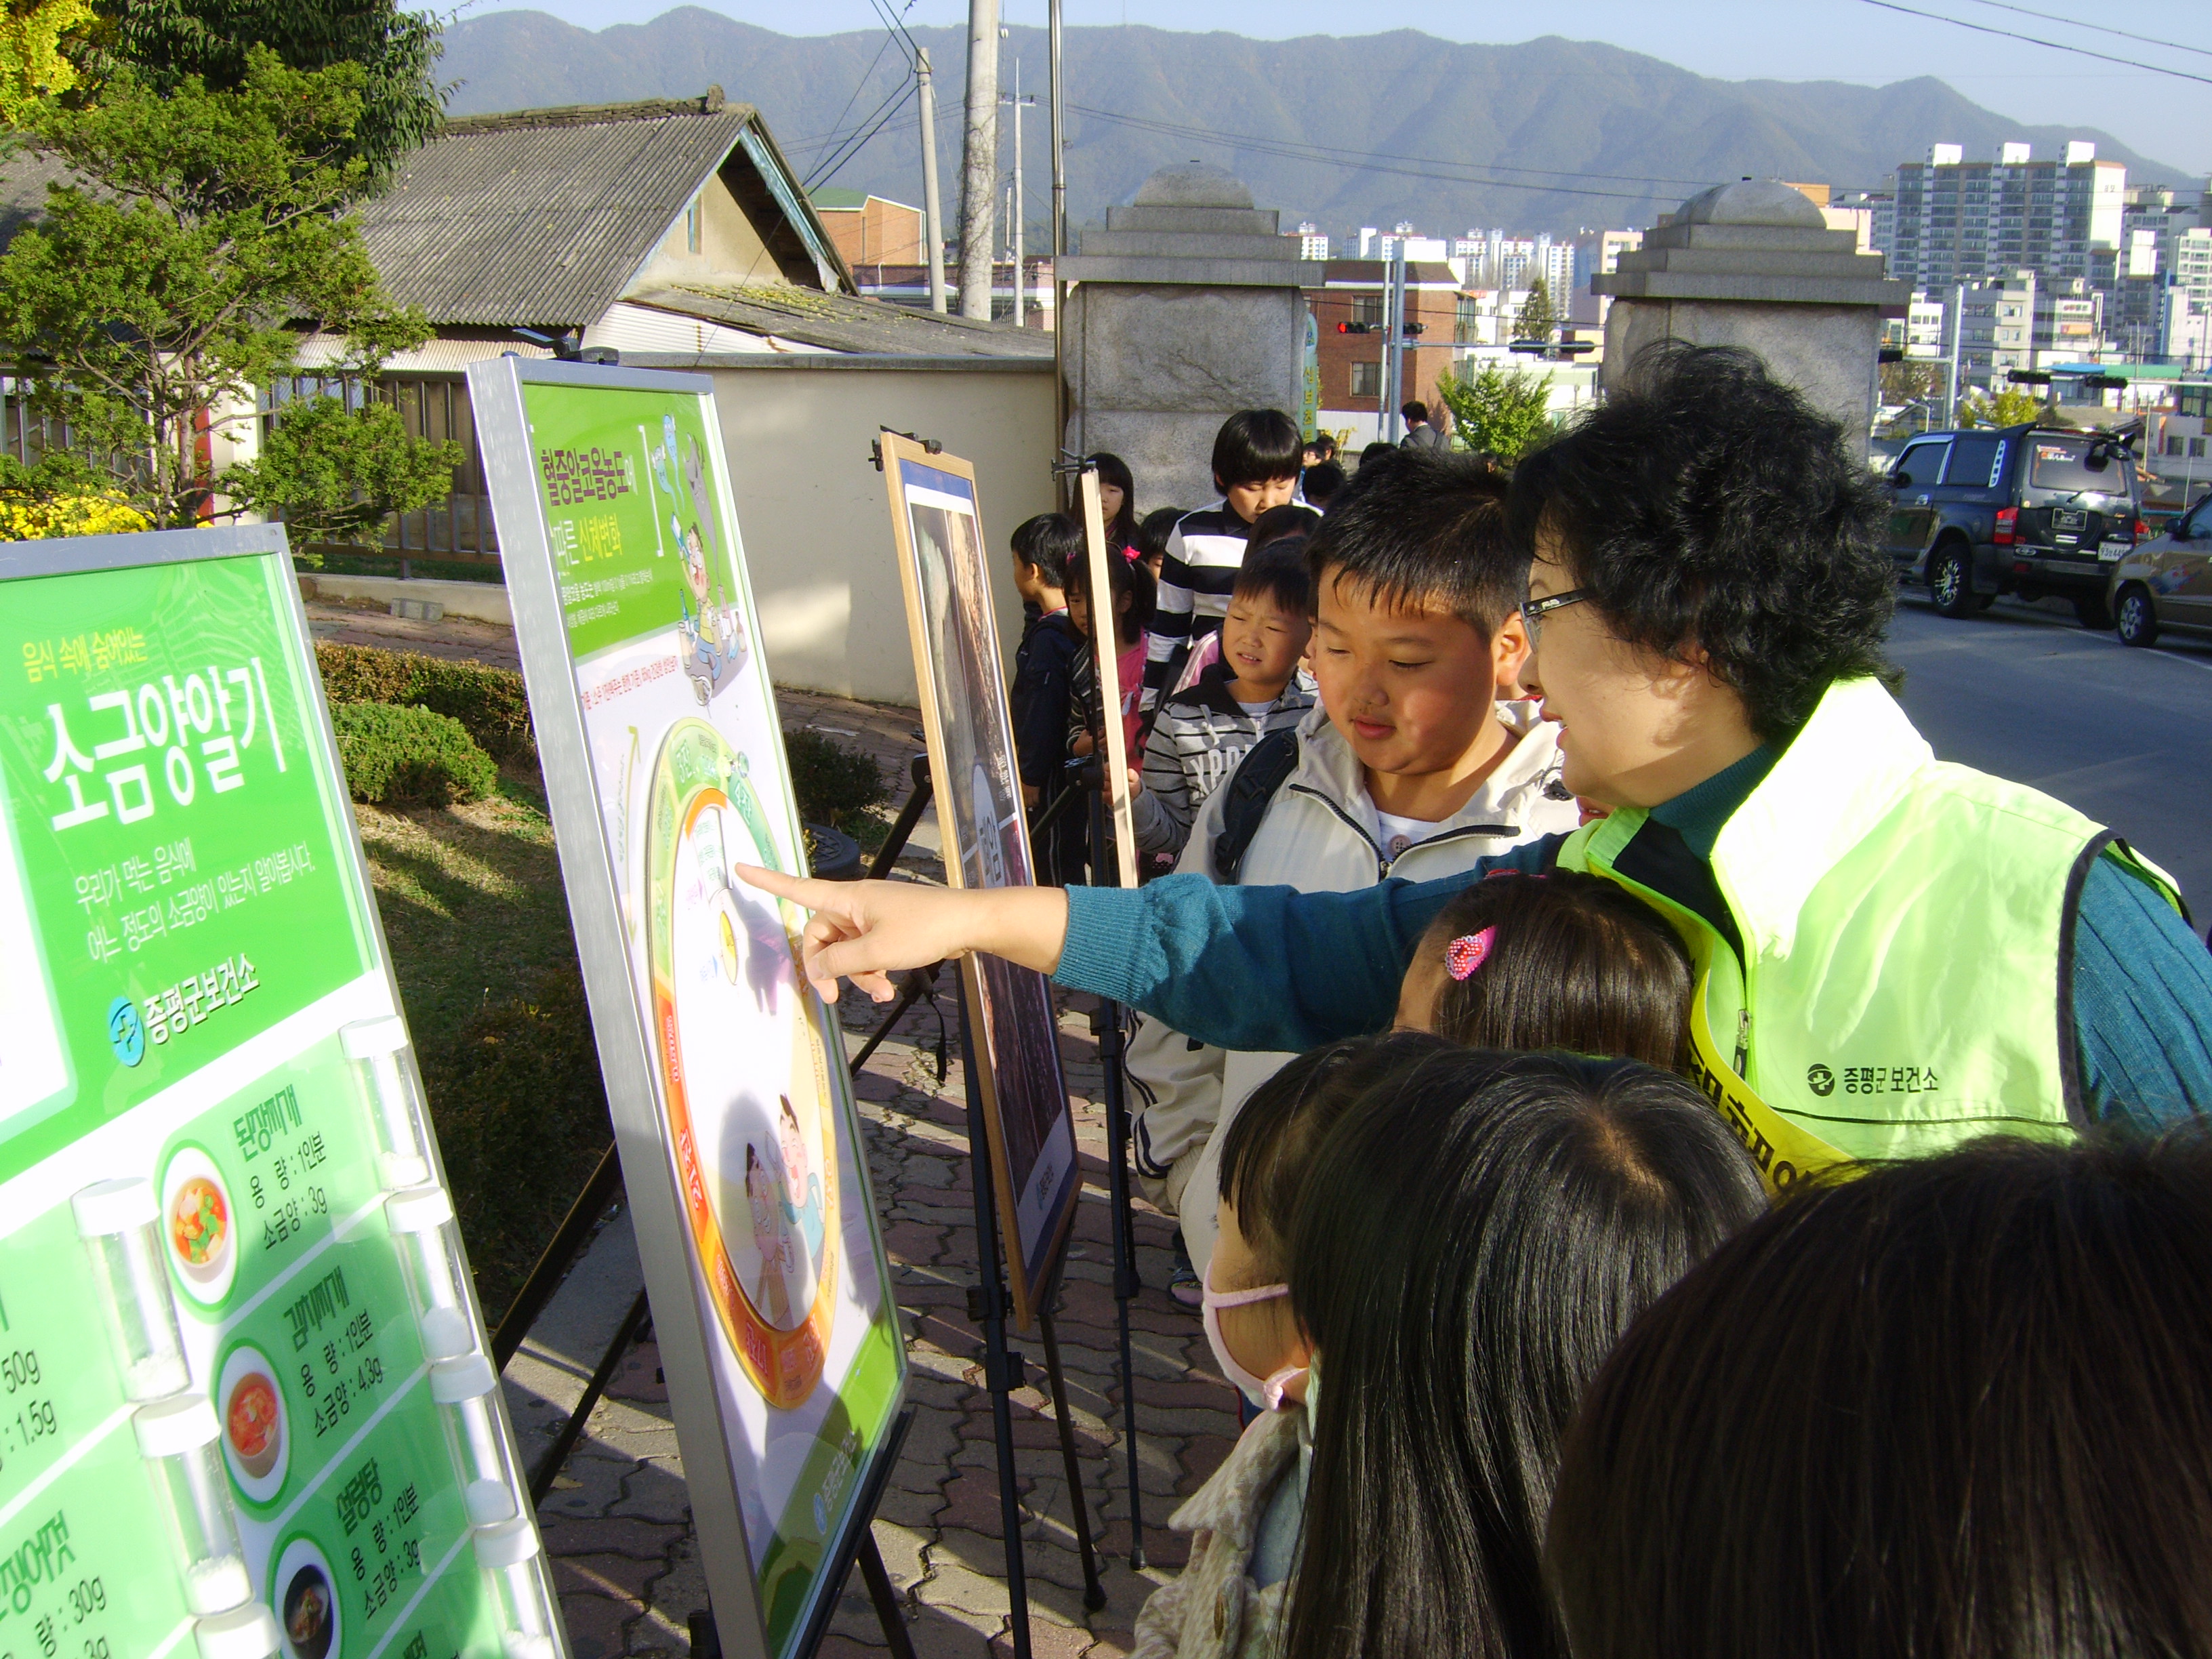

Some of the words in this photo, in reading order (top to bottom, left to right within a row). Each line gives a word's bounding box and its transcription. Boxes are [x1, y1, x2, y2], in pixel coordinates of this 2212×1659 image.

[541, 447, 638, 507] 혈중알코올농도에
[579, 512, 623, 562] 신체변화
[22, 639, 55, 683] 음식
[58, 632, 91, 672] 속에
[75, 865, 123, 916] 우리가
[121, 854, 154, 890] 먹는
[154, 836, 198, 886] 음식에
[86, 926, 120, 965] 어느
[120, 907, 165, 954] 정도의
[166, 877, 220, 933] 소금양이
[218, 871, 255, 910] 있는지
[144, 952, 261, 1046] 증평군보건소
[1843, 1066, 1940, 1095] 증평군보건소
[233, 1084, 303, 1162] 된장찌개
[250, 1174, 265, 1210] 용
[297, 1130, 327, 1173] 1인분
[264, 1197, 301, 1251] 소금양
[308, 1185, 328, 1214] 3g
[283, 1265, 350, 1353] 김치찌개
[301, 1363, 316, 1398] 용
[345, 1308, 373, 1353] 1인분
[16, 1398, 58, 1448] 1.5g
[314, 1380, 350, 1438] 소금양
[358, 1356, 384, 1392] 4.3g
[336, 1457, 383, 1536] 설렁탕
[351, 1546, 366, 1582] 용
[392, 1481, 419, 1529] 1인분
[0, 1509, 76, 1622] 징어젓
[364, 1558, 398, 1620] 소금양
[403, 1538, 421, 1569] 3g
[35, 1612, 57, 1658] 량
[68, 1576, 107, 1625] 30g
